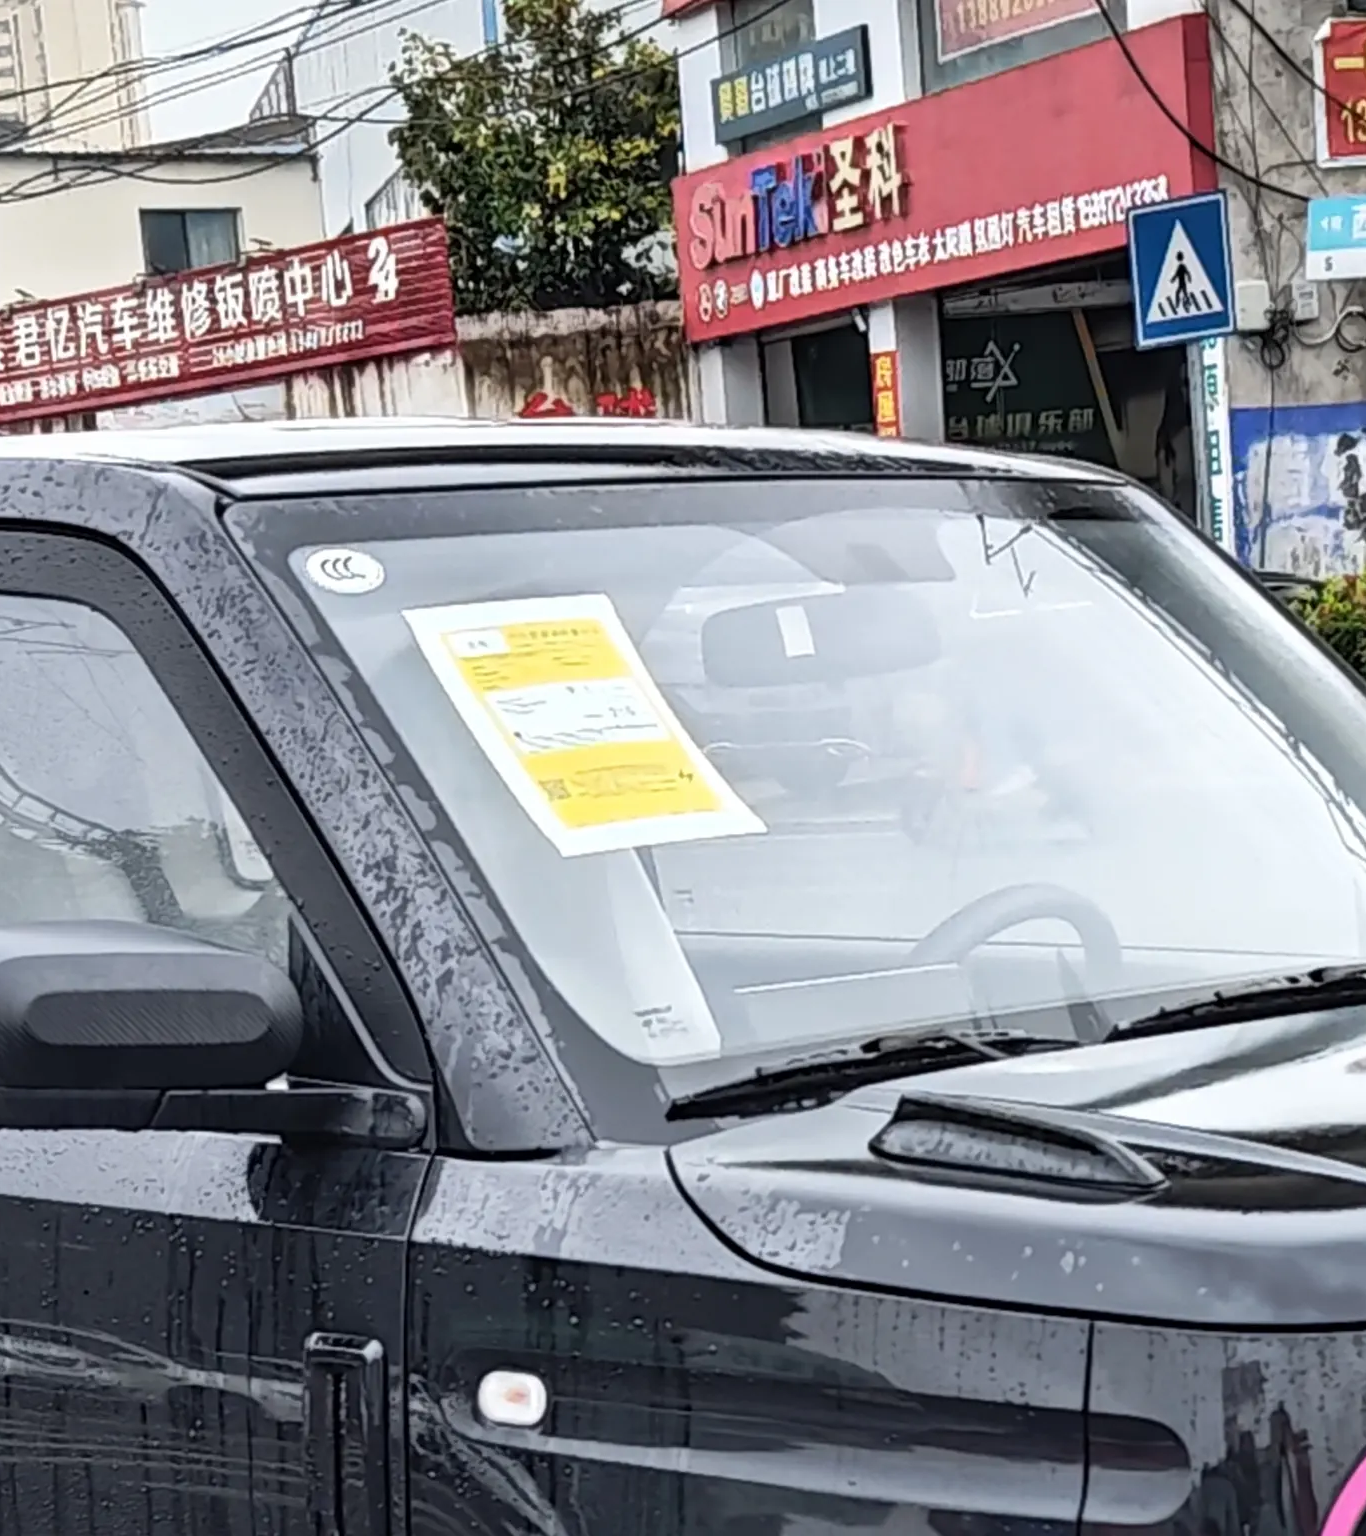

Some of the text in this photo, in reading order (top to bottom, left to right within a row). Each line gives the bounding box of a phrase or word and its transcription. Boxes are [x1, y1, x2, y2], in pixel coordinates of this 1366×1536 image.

[829, 122, 903, 233] 圣科
[12, 250, 353, 369] 君忆汽车维修钣喷中心
